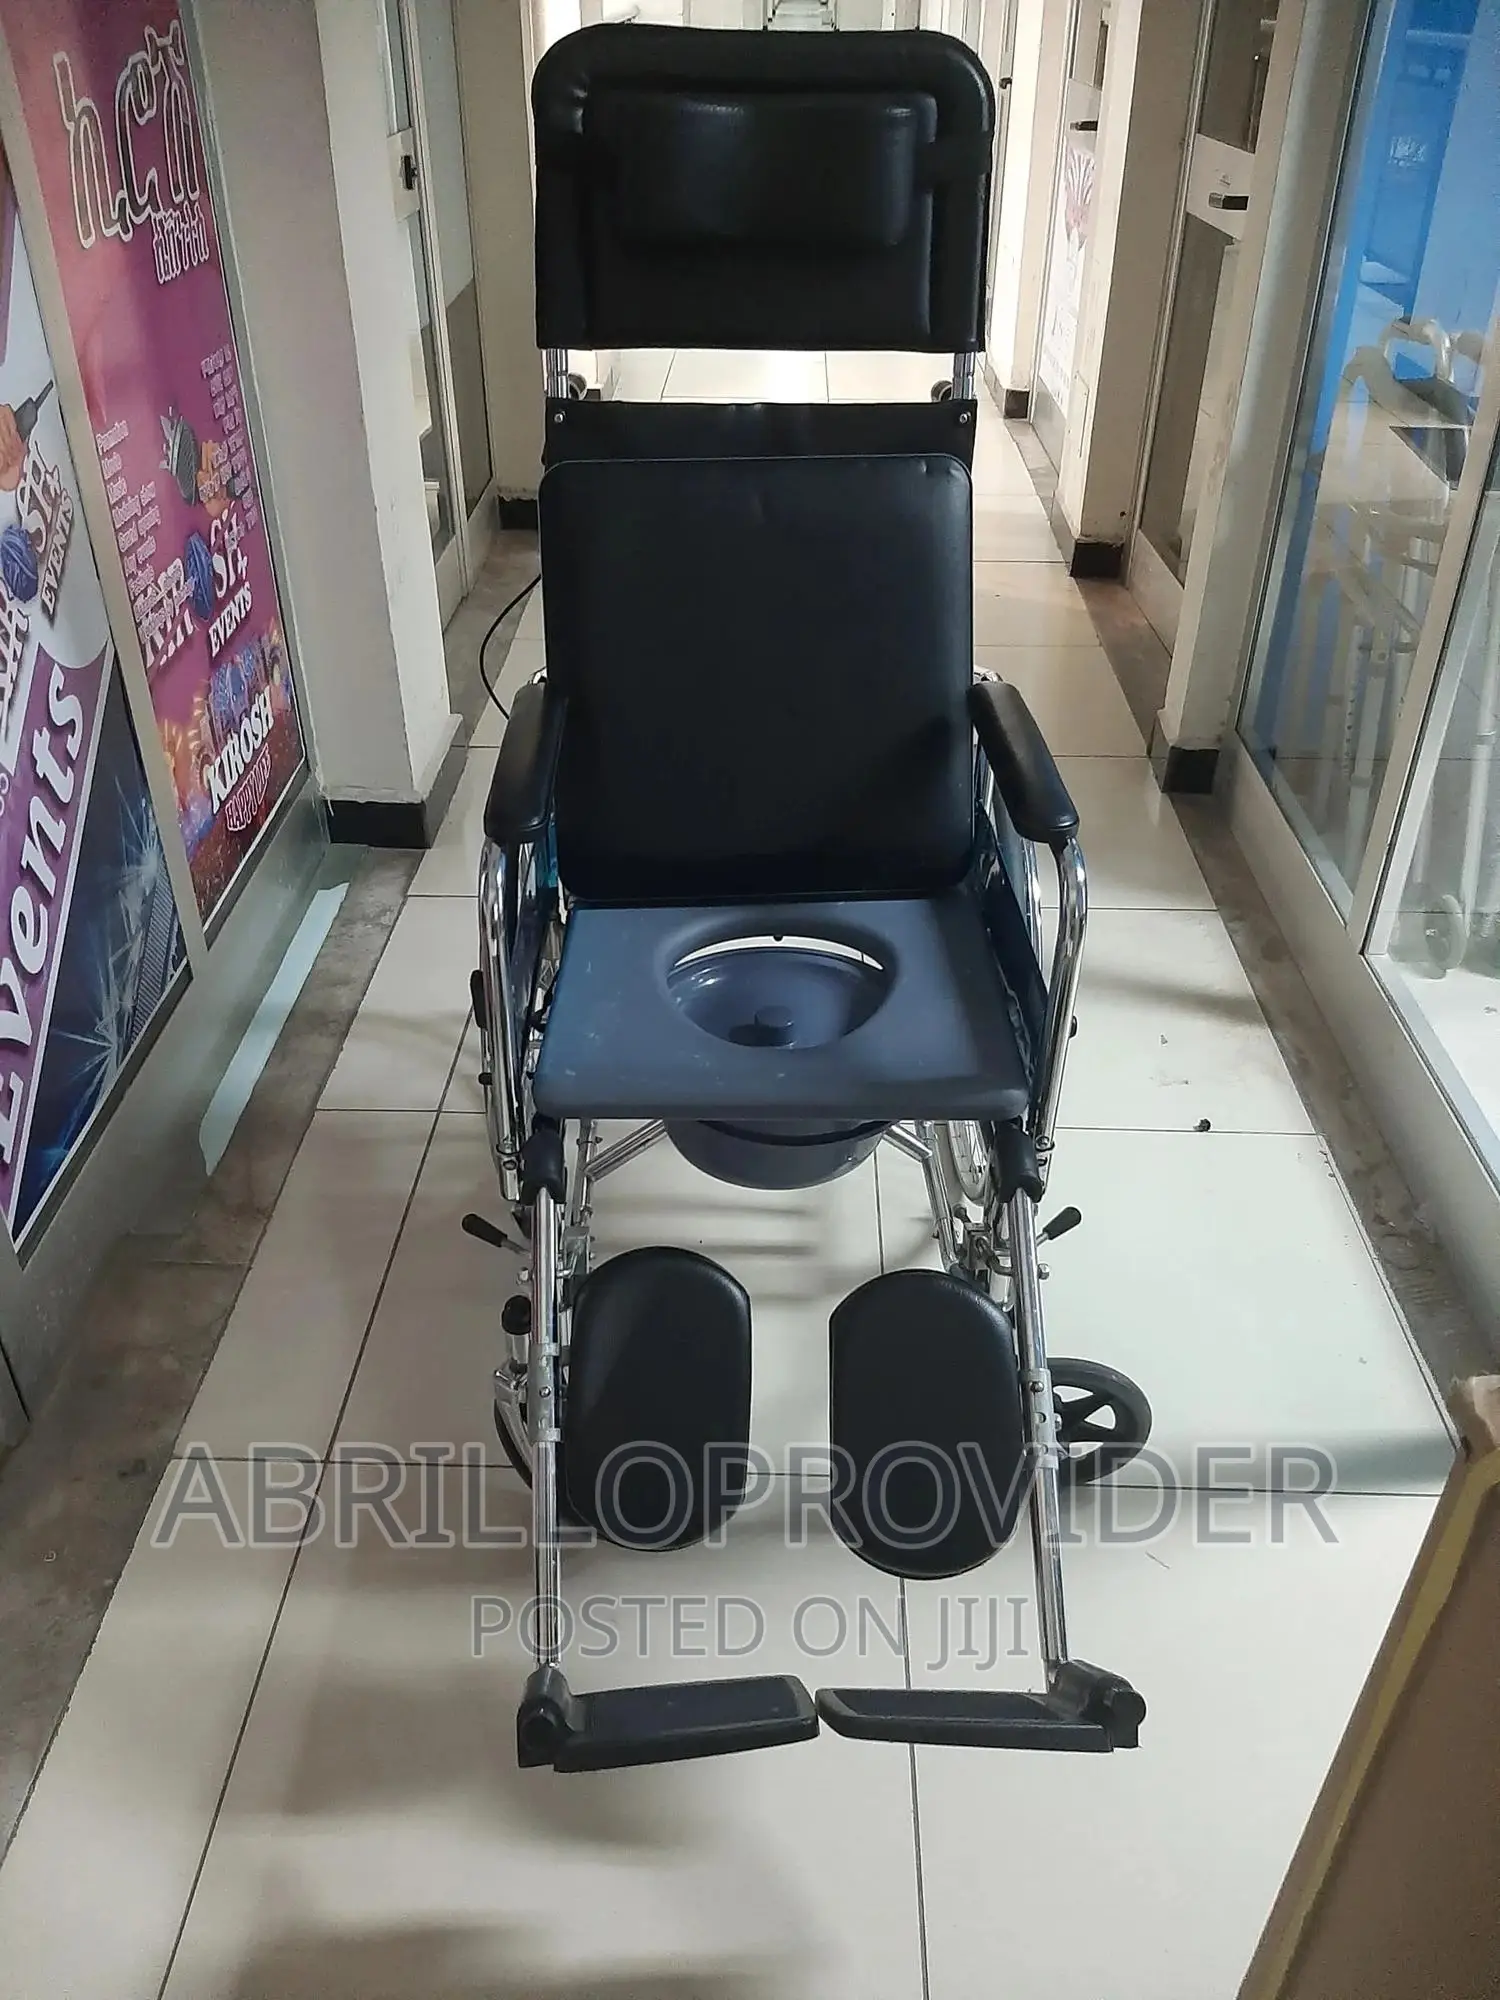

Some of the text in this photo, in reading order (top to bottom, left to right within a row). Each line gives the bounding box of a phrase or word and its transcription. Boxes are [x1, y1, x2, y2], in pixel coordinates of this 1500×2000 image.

[41, 488, 74, 617] EVENTS
[208, 580, 253, 658] EVENTS
[207, 686, 274, 814] KIROSH
